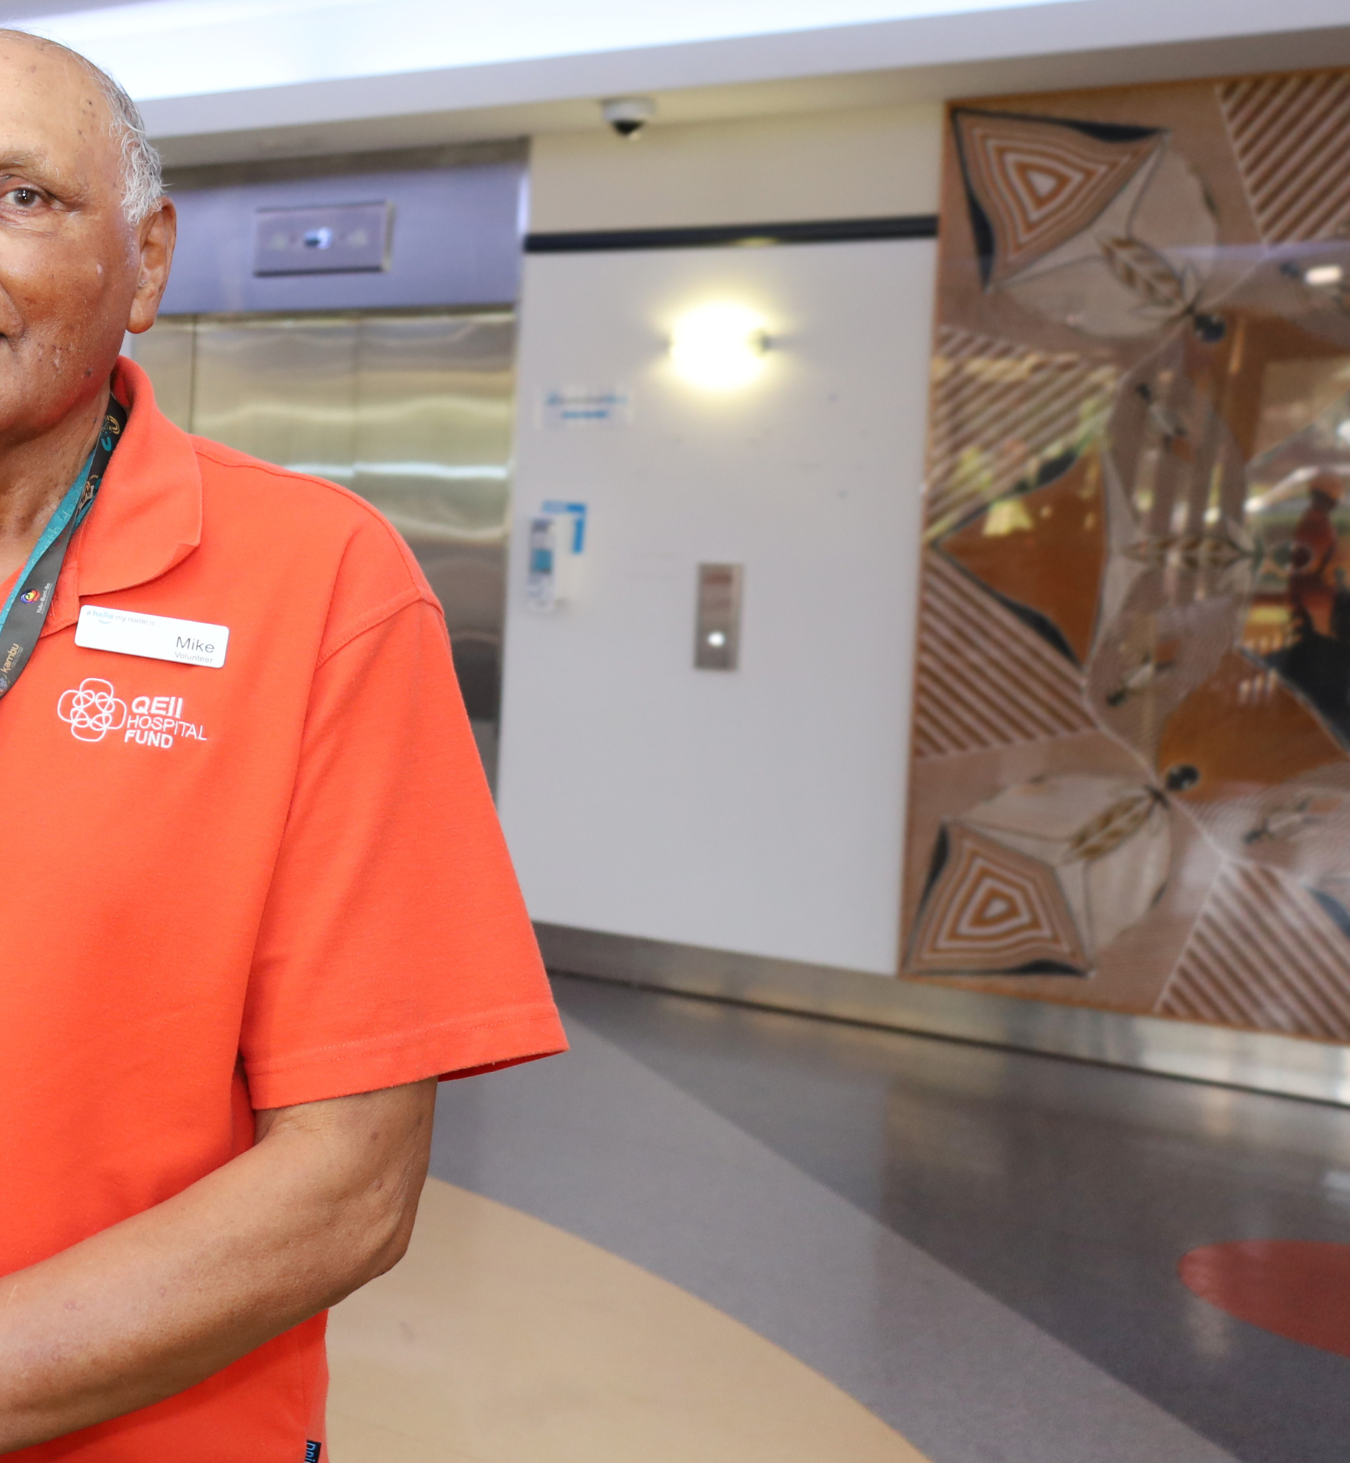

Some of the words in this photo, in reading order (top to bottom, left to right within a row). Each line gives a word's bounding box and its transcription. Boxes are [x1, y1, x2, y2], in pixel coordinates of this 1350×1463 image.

[115, 614, 126, 623] my
[127, 616, 149, 625] name
[175, 635, 215, 654] Mike
[0, 643, 20, 674] kambu
[174, 651, 214, 663] Volunteer
[127, 715, 208, 741] HOSPITAL
[124, 729, 174, 749] FUND
